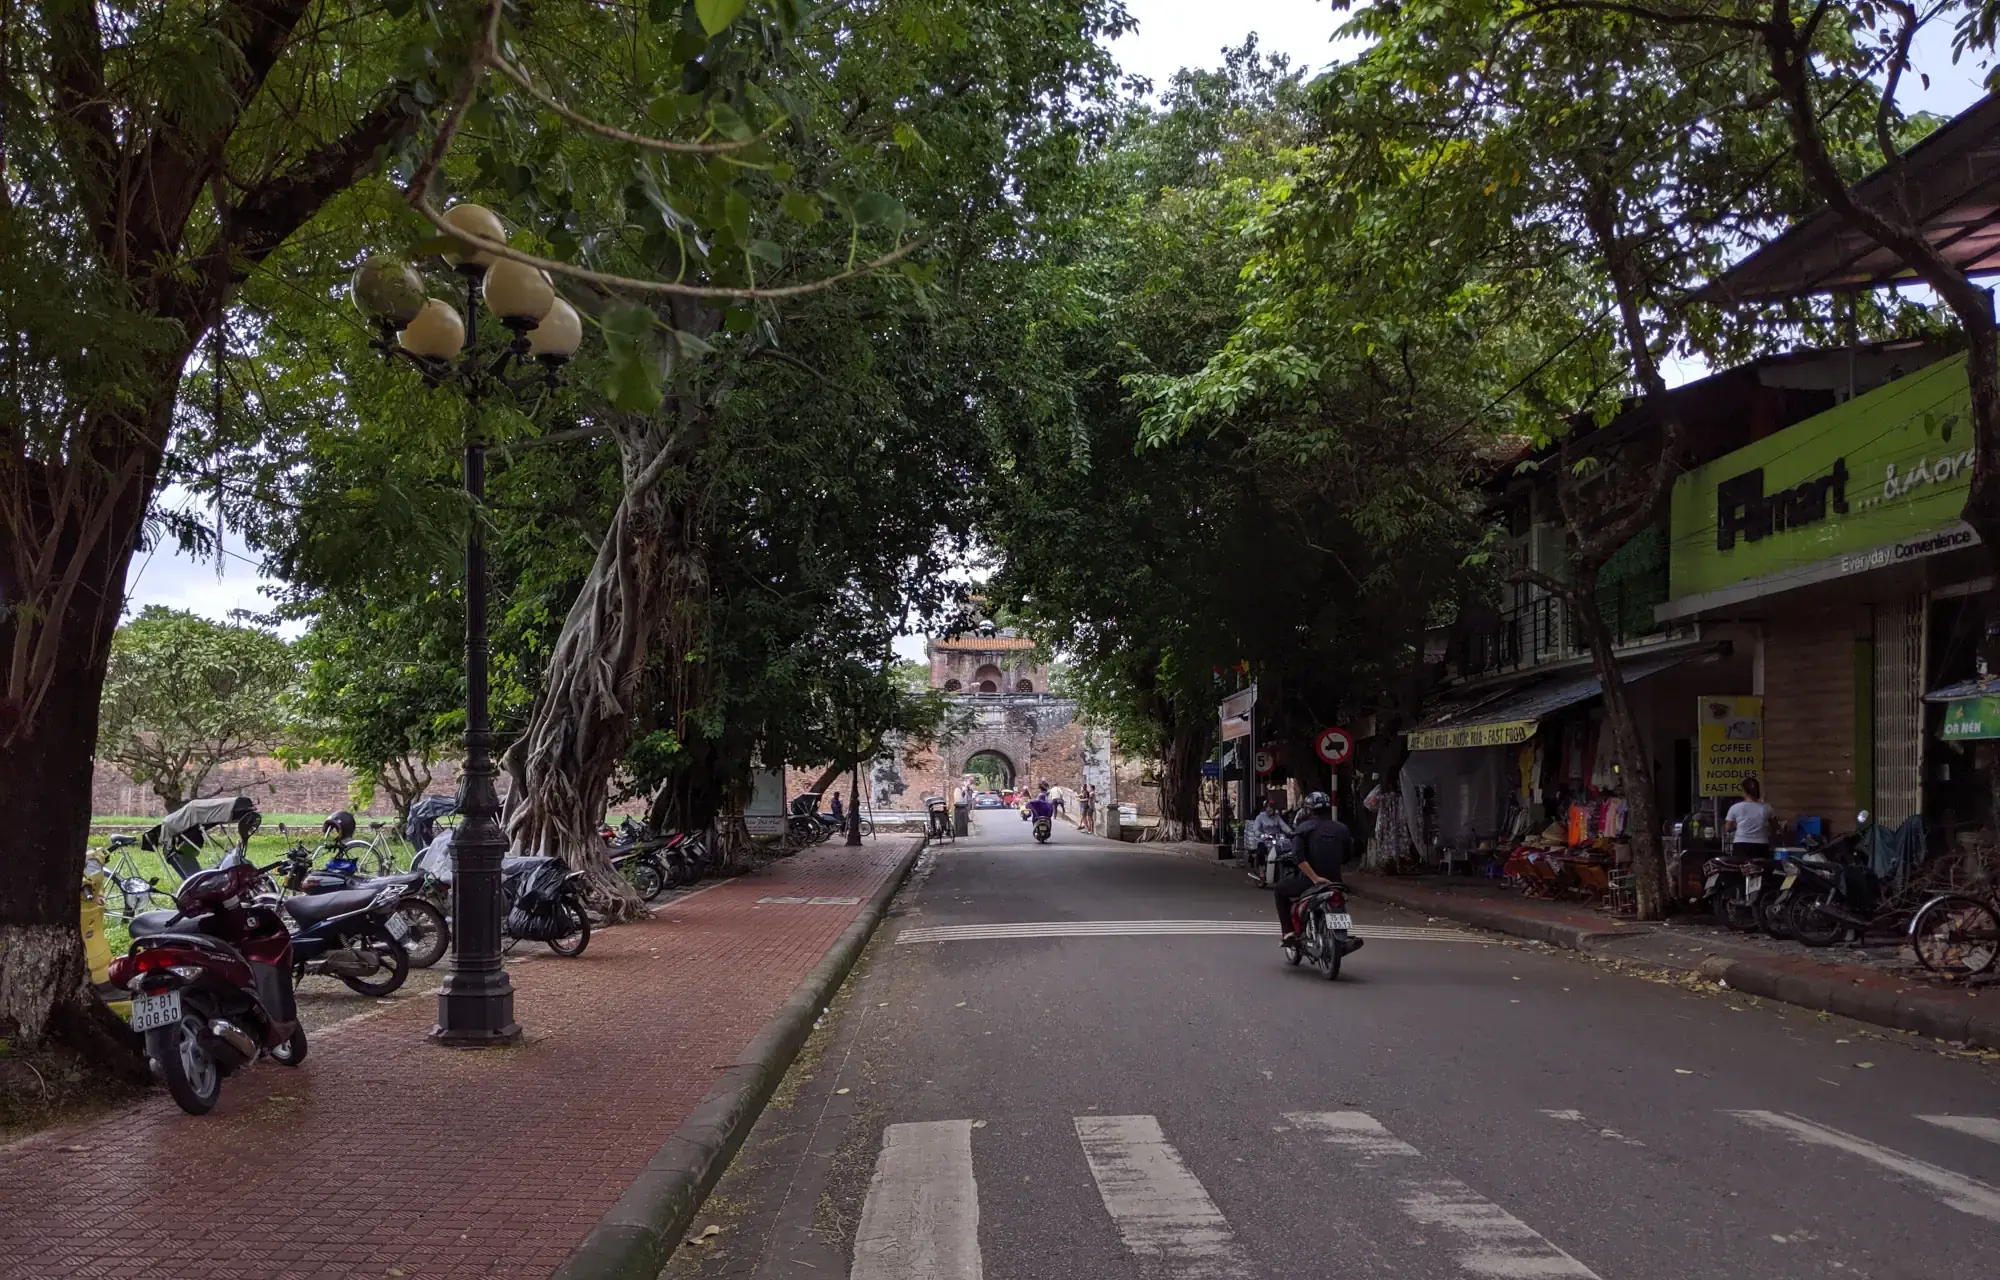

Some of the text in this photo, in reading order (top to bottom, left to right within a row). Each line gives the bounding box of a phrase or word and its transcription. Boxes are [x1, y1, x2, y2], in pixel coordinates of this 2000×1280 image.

[1841, 530, 1971, 572] Everyday Convenience
[1487, 728, 1504, 744] FAST
[1505, 726, 1525, 743] FOOD
[1711, 743, 1752, 753] COFFEE
[1709, 757, 1754, 765] VITAMIN
[1707, 769, 1757, 779] NOODLES
[1705, 783, 1728, 792] FAST
[137, 1007, 178, 1029] 308.60
